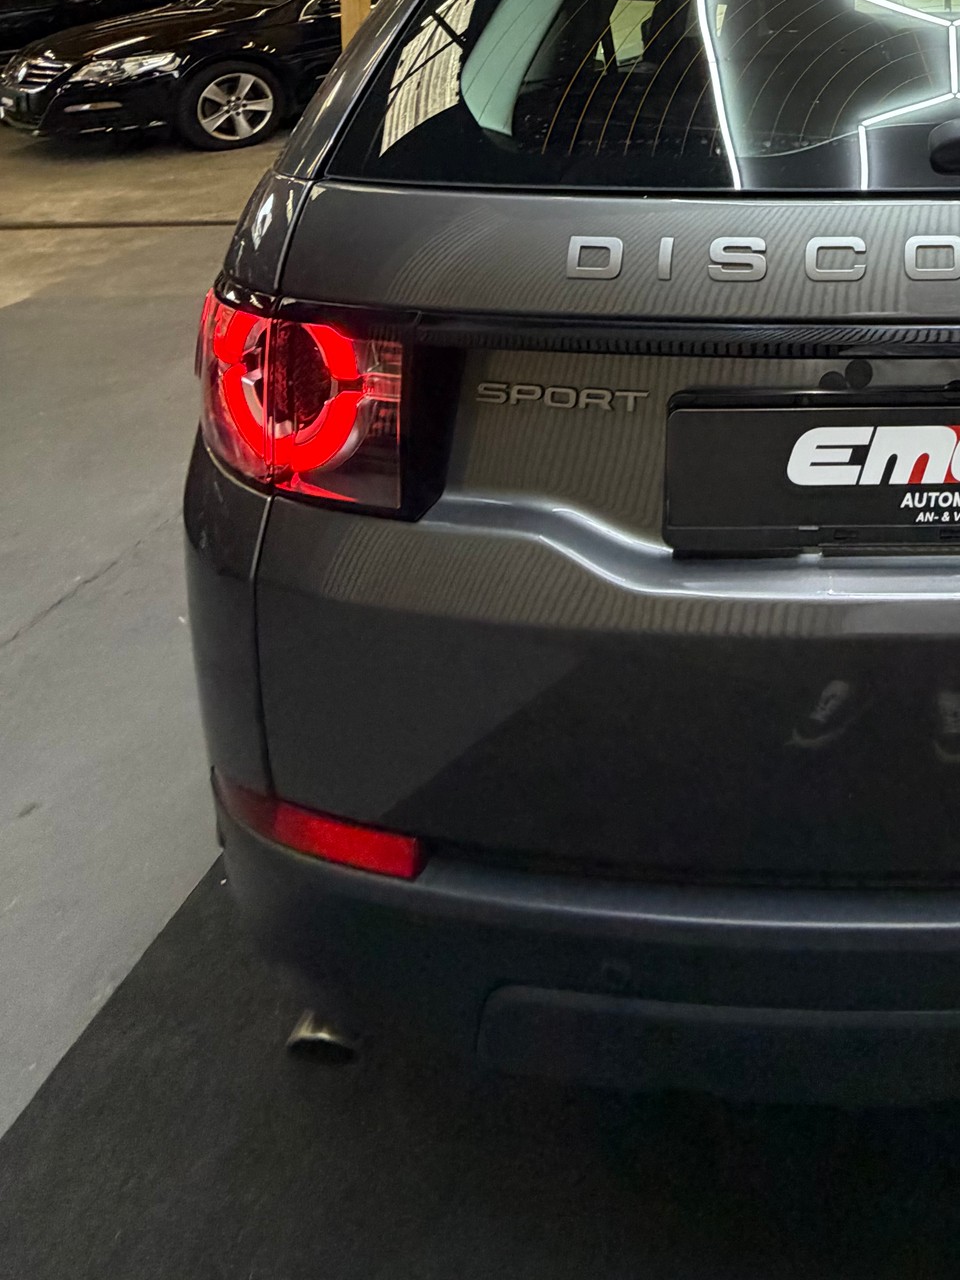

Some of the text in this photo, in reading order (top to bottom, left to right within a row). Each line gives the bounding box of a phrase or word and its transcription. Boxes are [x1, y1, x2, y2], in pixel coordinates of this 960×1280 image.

[475, 381, 649, 412] SPORT
[915, 511, 939, 523] AN-
[941, 511, 951, 521] &
